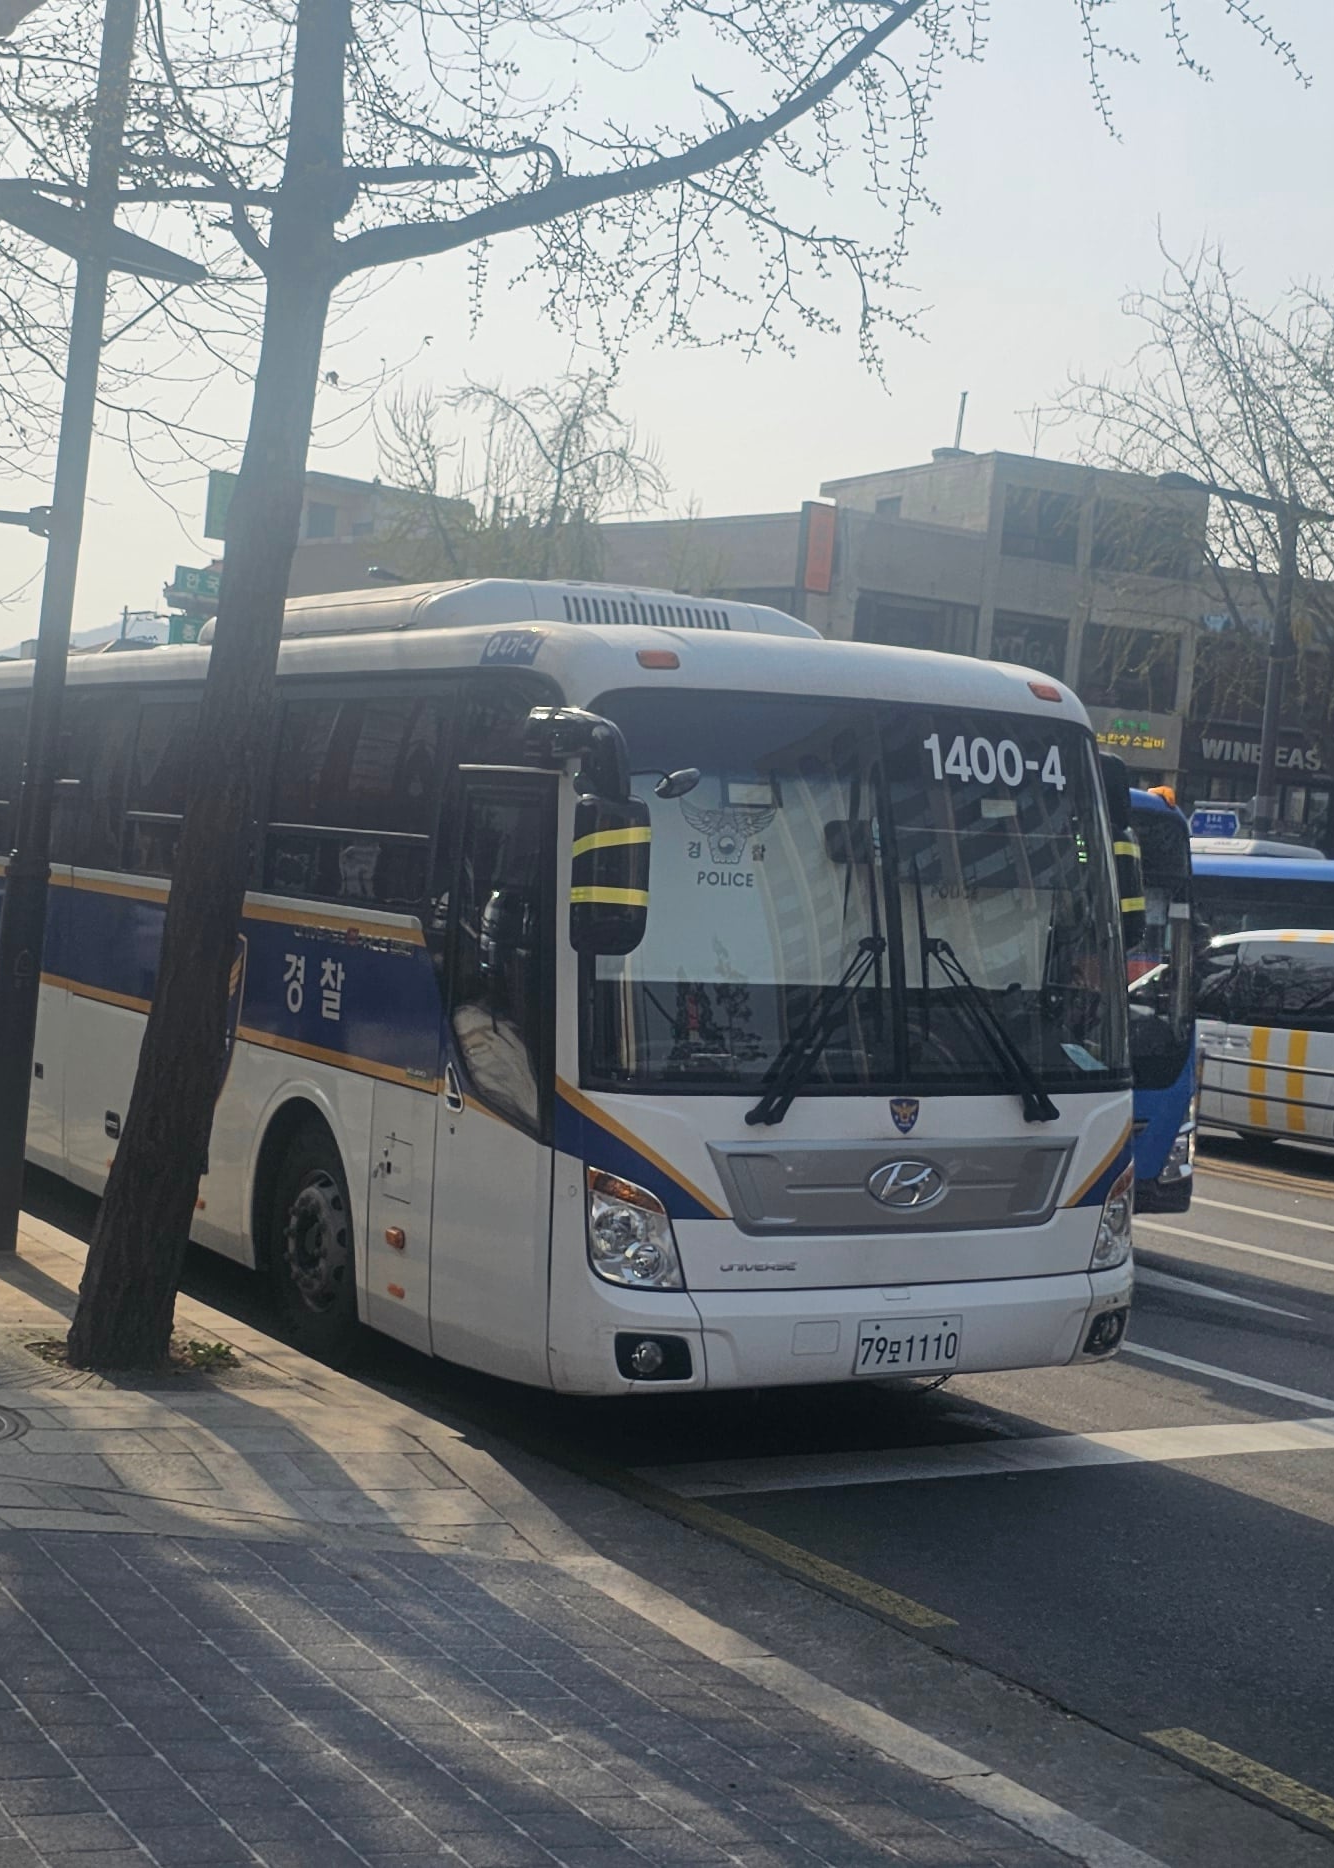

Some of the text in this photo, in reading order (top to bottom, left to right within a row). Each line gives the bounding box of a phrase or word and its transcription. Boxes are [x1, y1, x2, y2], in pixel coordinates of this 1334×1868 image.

[995, 636, 1058, 671] YOGA
[1133, 737, 1165, 750] 소갈비
[923, 733, 1066, 791] 1400-4
[687, 841, 701, 858] 경
[697, 871, 754, 888] POLICE
[283, 953, 345, 1021] 경찰
[720, 1262, 798, 1272] UNIVERSE
[860, 1332, 958, 1366] 79모1110
